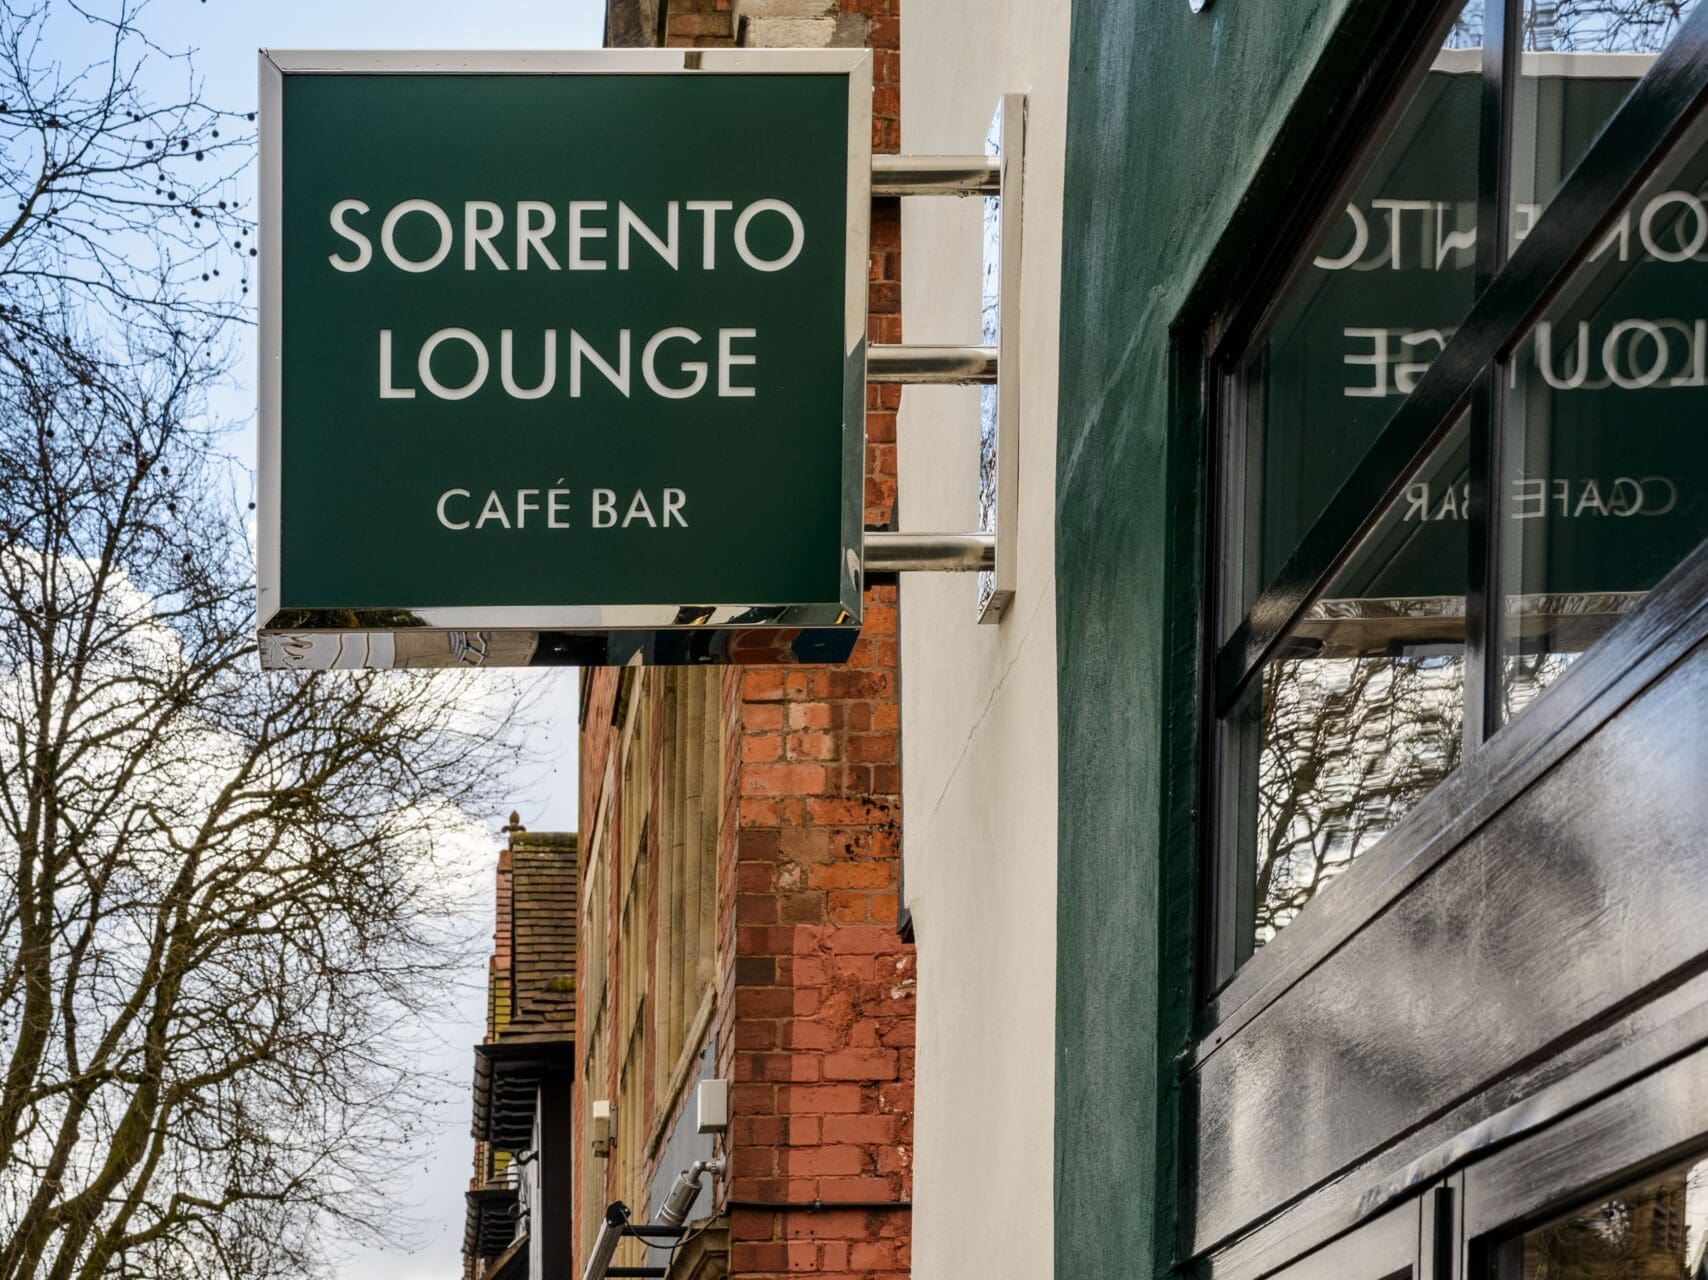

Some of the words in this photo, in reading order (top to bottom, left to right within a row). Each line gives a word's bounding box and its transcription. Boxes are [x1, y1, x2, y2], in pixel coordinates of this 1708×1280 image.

[328, 198, 805, 273] SORRENTO
[379, 326, 757, 401] LOUNGE
[436, 477, 571, 530] CAFÉ
[592, 488, 689, 529] BAR
